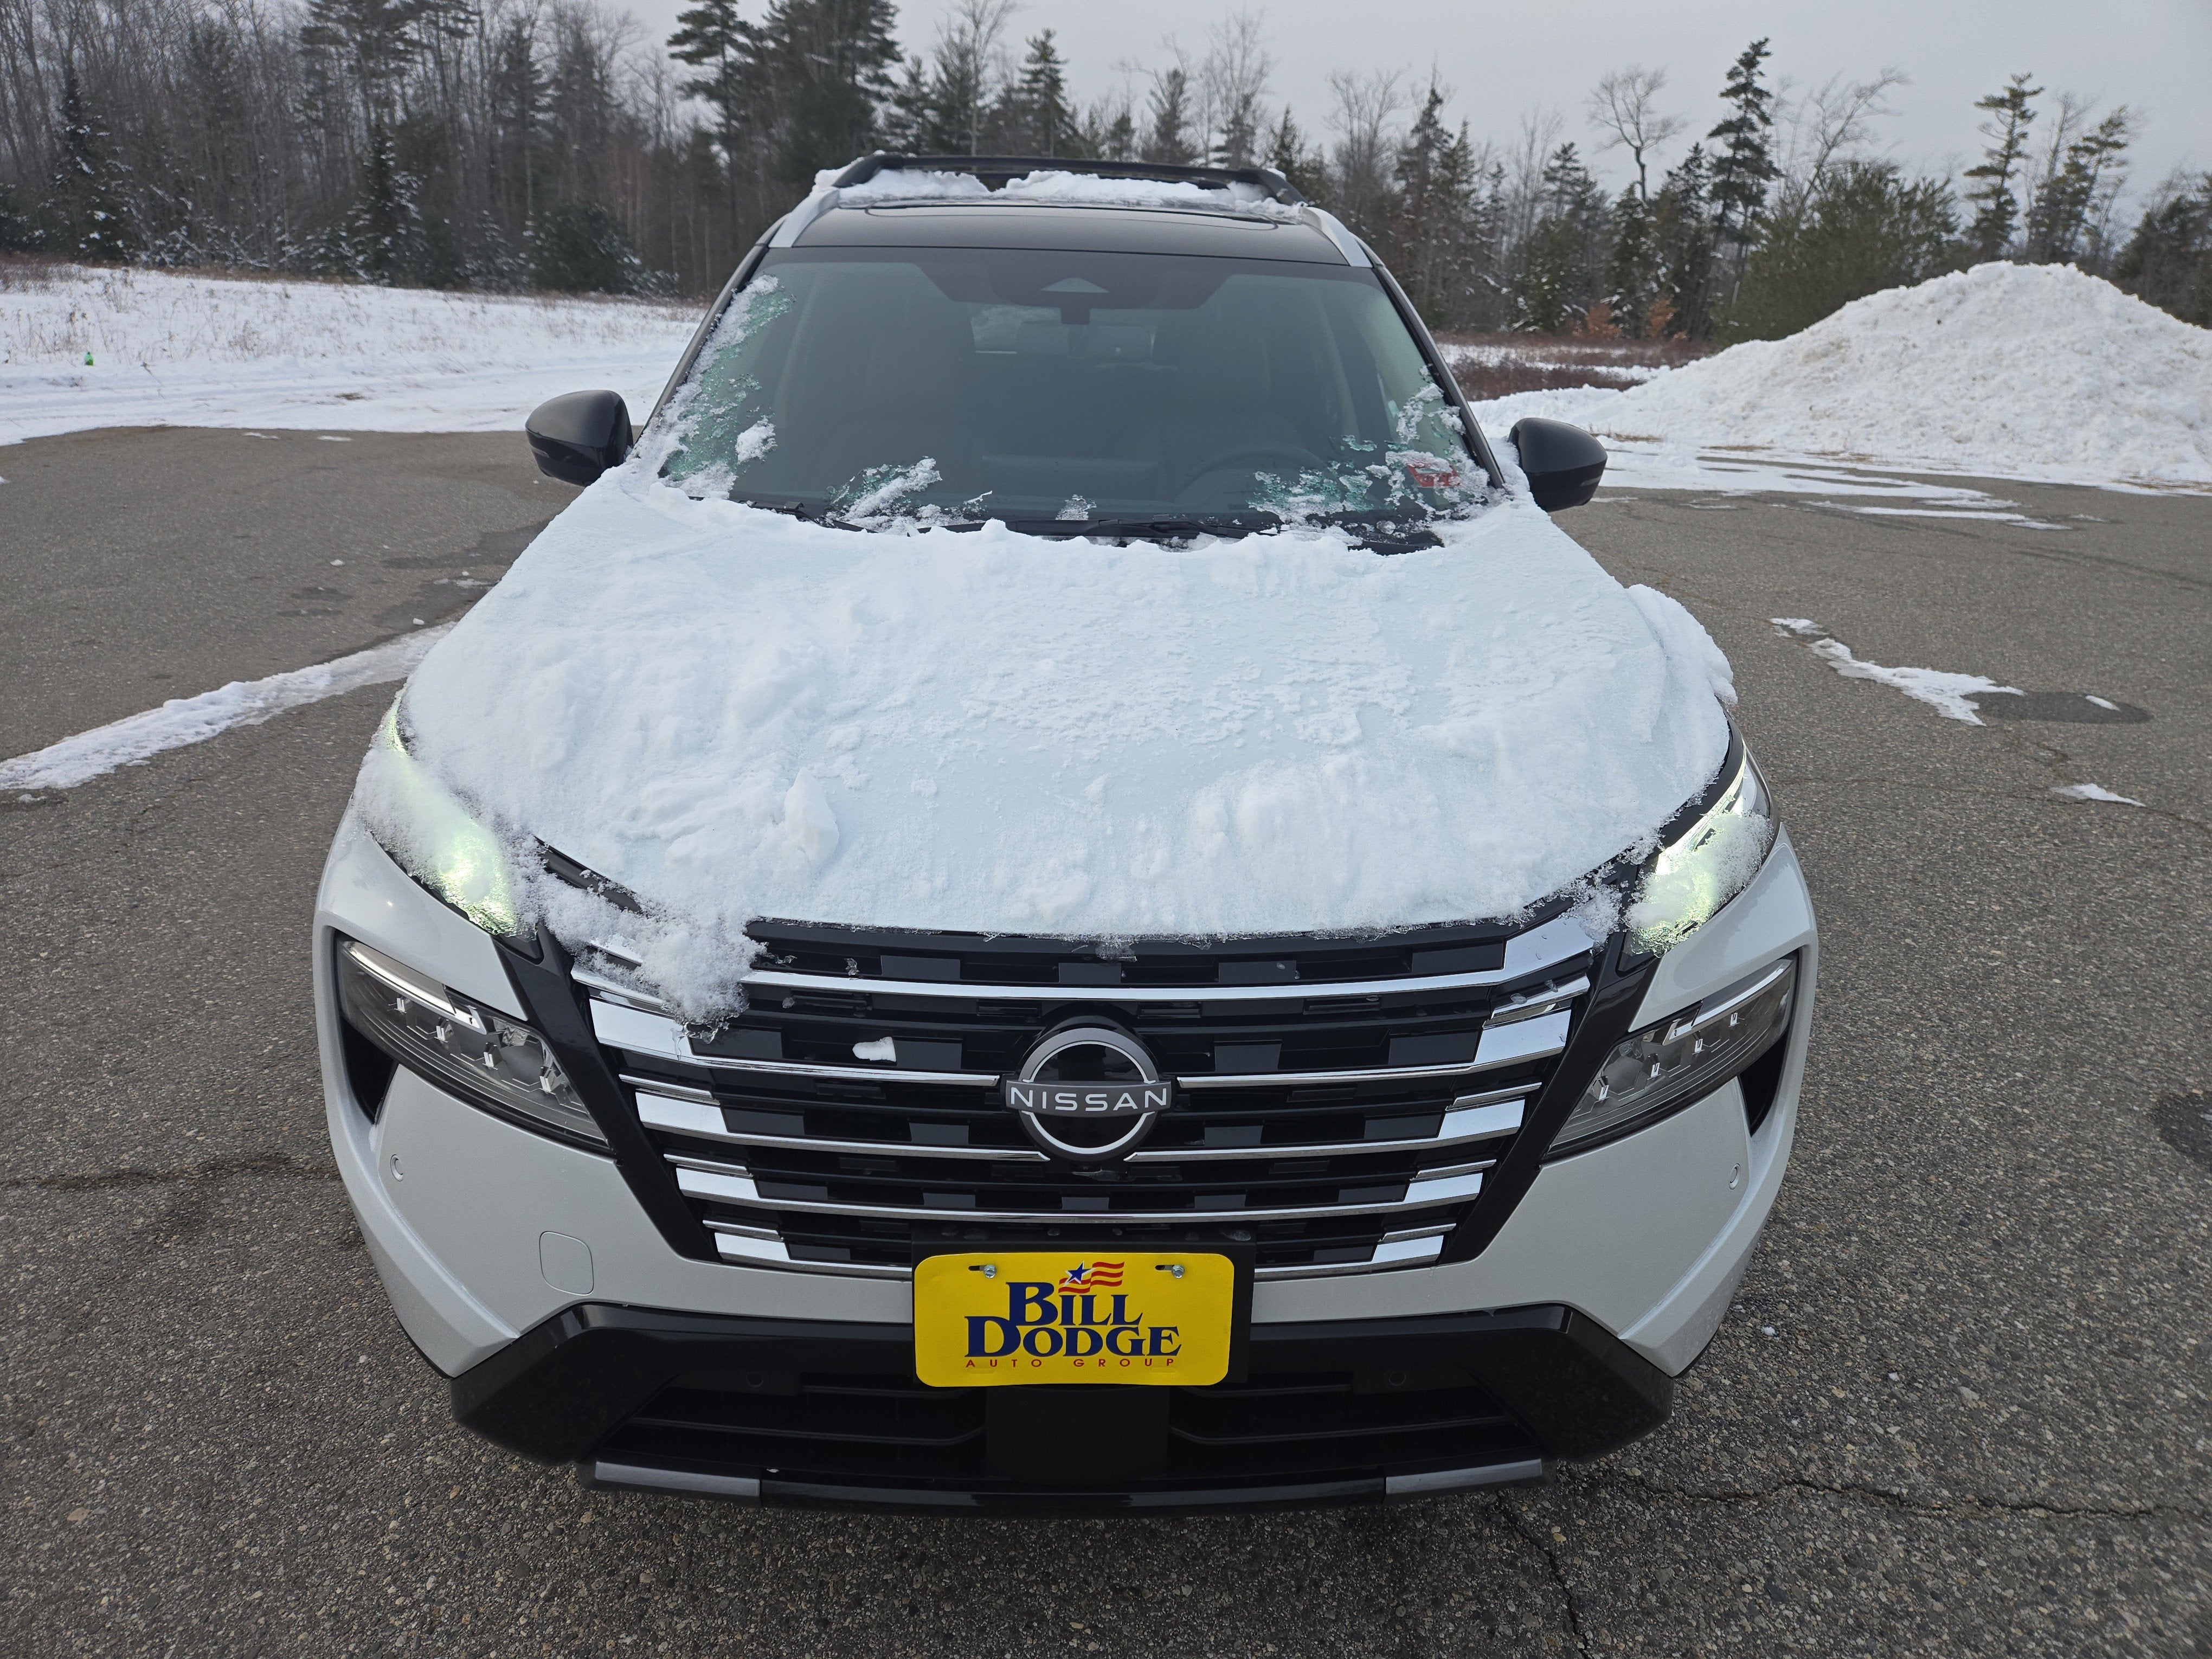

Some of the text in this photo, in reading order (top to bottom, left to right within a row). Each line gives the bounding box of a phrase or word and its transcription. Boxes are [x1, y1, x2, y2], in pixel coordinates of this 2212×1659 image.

[1010, 1087, 1167, 1111] NISSAN
[1006, 1282, 1143, 1326] BILL
[964, 1316, 1182, 1358] DODGE
[965, 1358, 1175, 1368] AUTO GROUP
